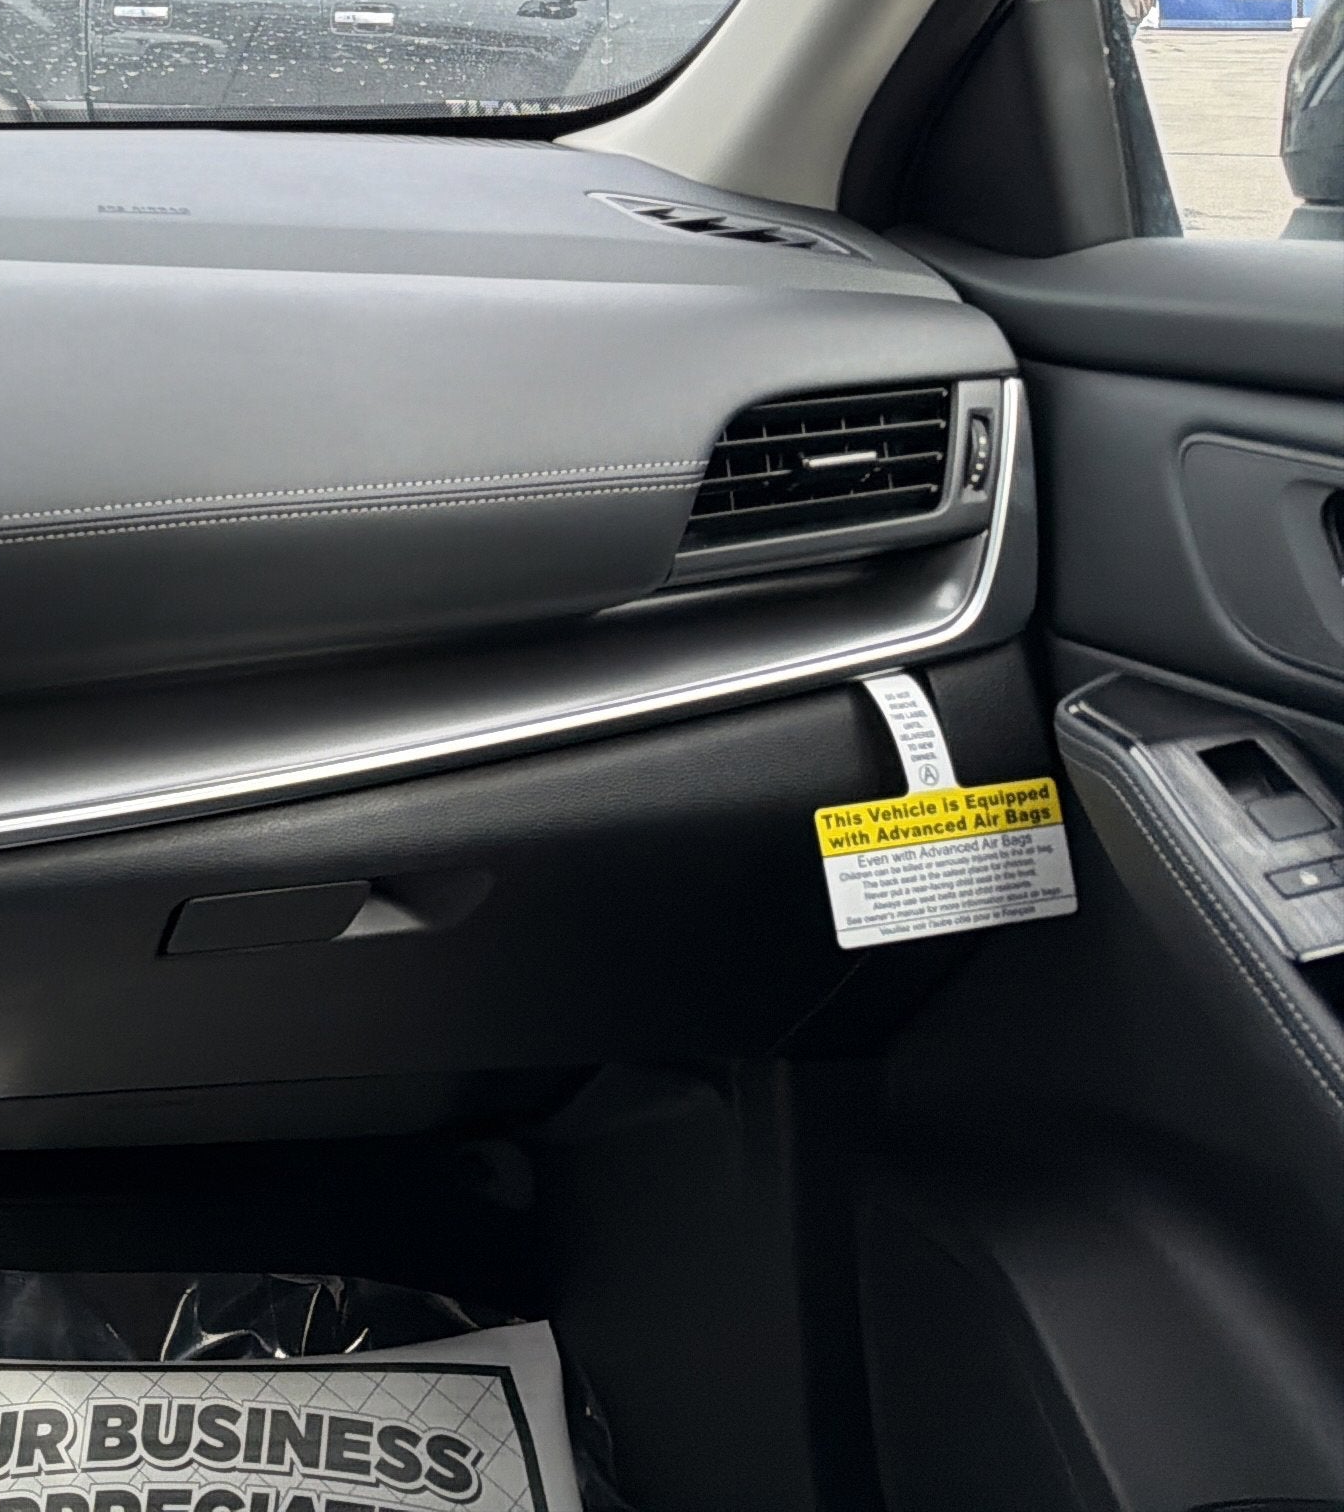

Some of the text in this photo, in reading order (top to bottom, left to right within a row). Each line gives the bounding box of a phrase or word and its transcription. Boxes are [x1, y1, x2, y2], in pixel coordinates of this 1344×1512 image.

[821, 811, 863, 830] This
[866, 800, 937, 823] Vehicle
[964, 783, 1050, 810] Equipped
[829, 807, 1051, 849] with Advanced Air Bags
[857, 833, 1033, 869] Even with Advanced Air Bags
[87, 1402, 479, 1496] BUSINESS
